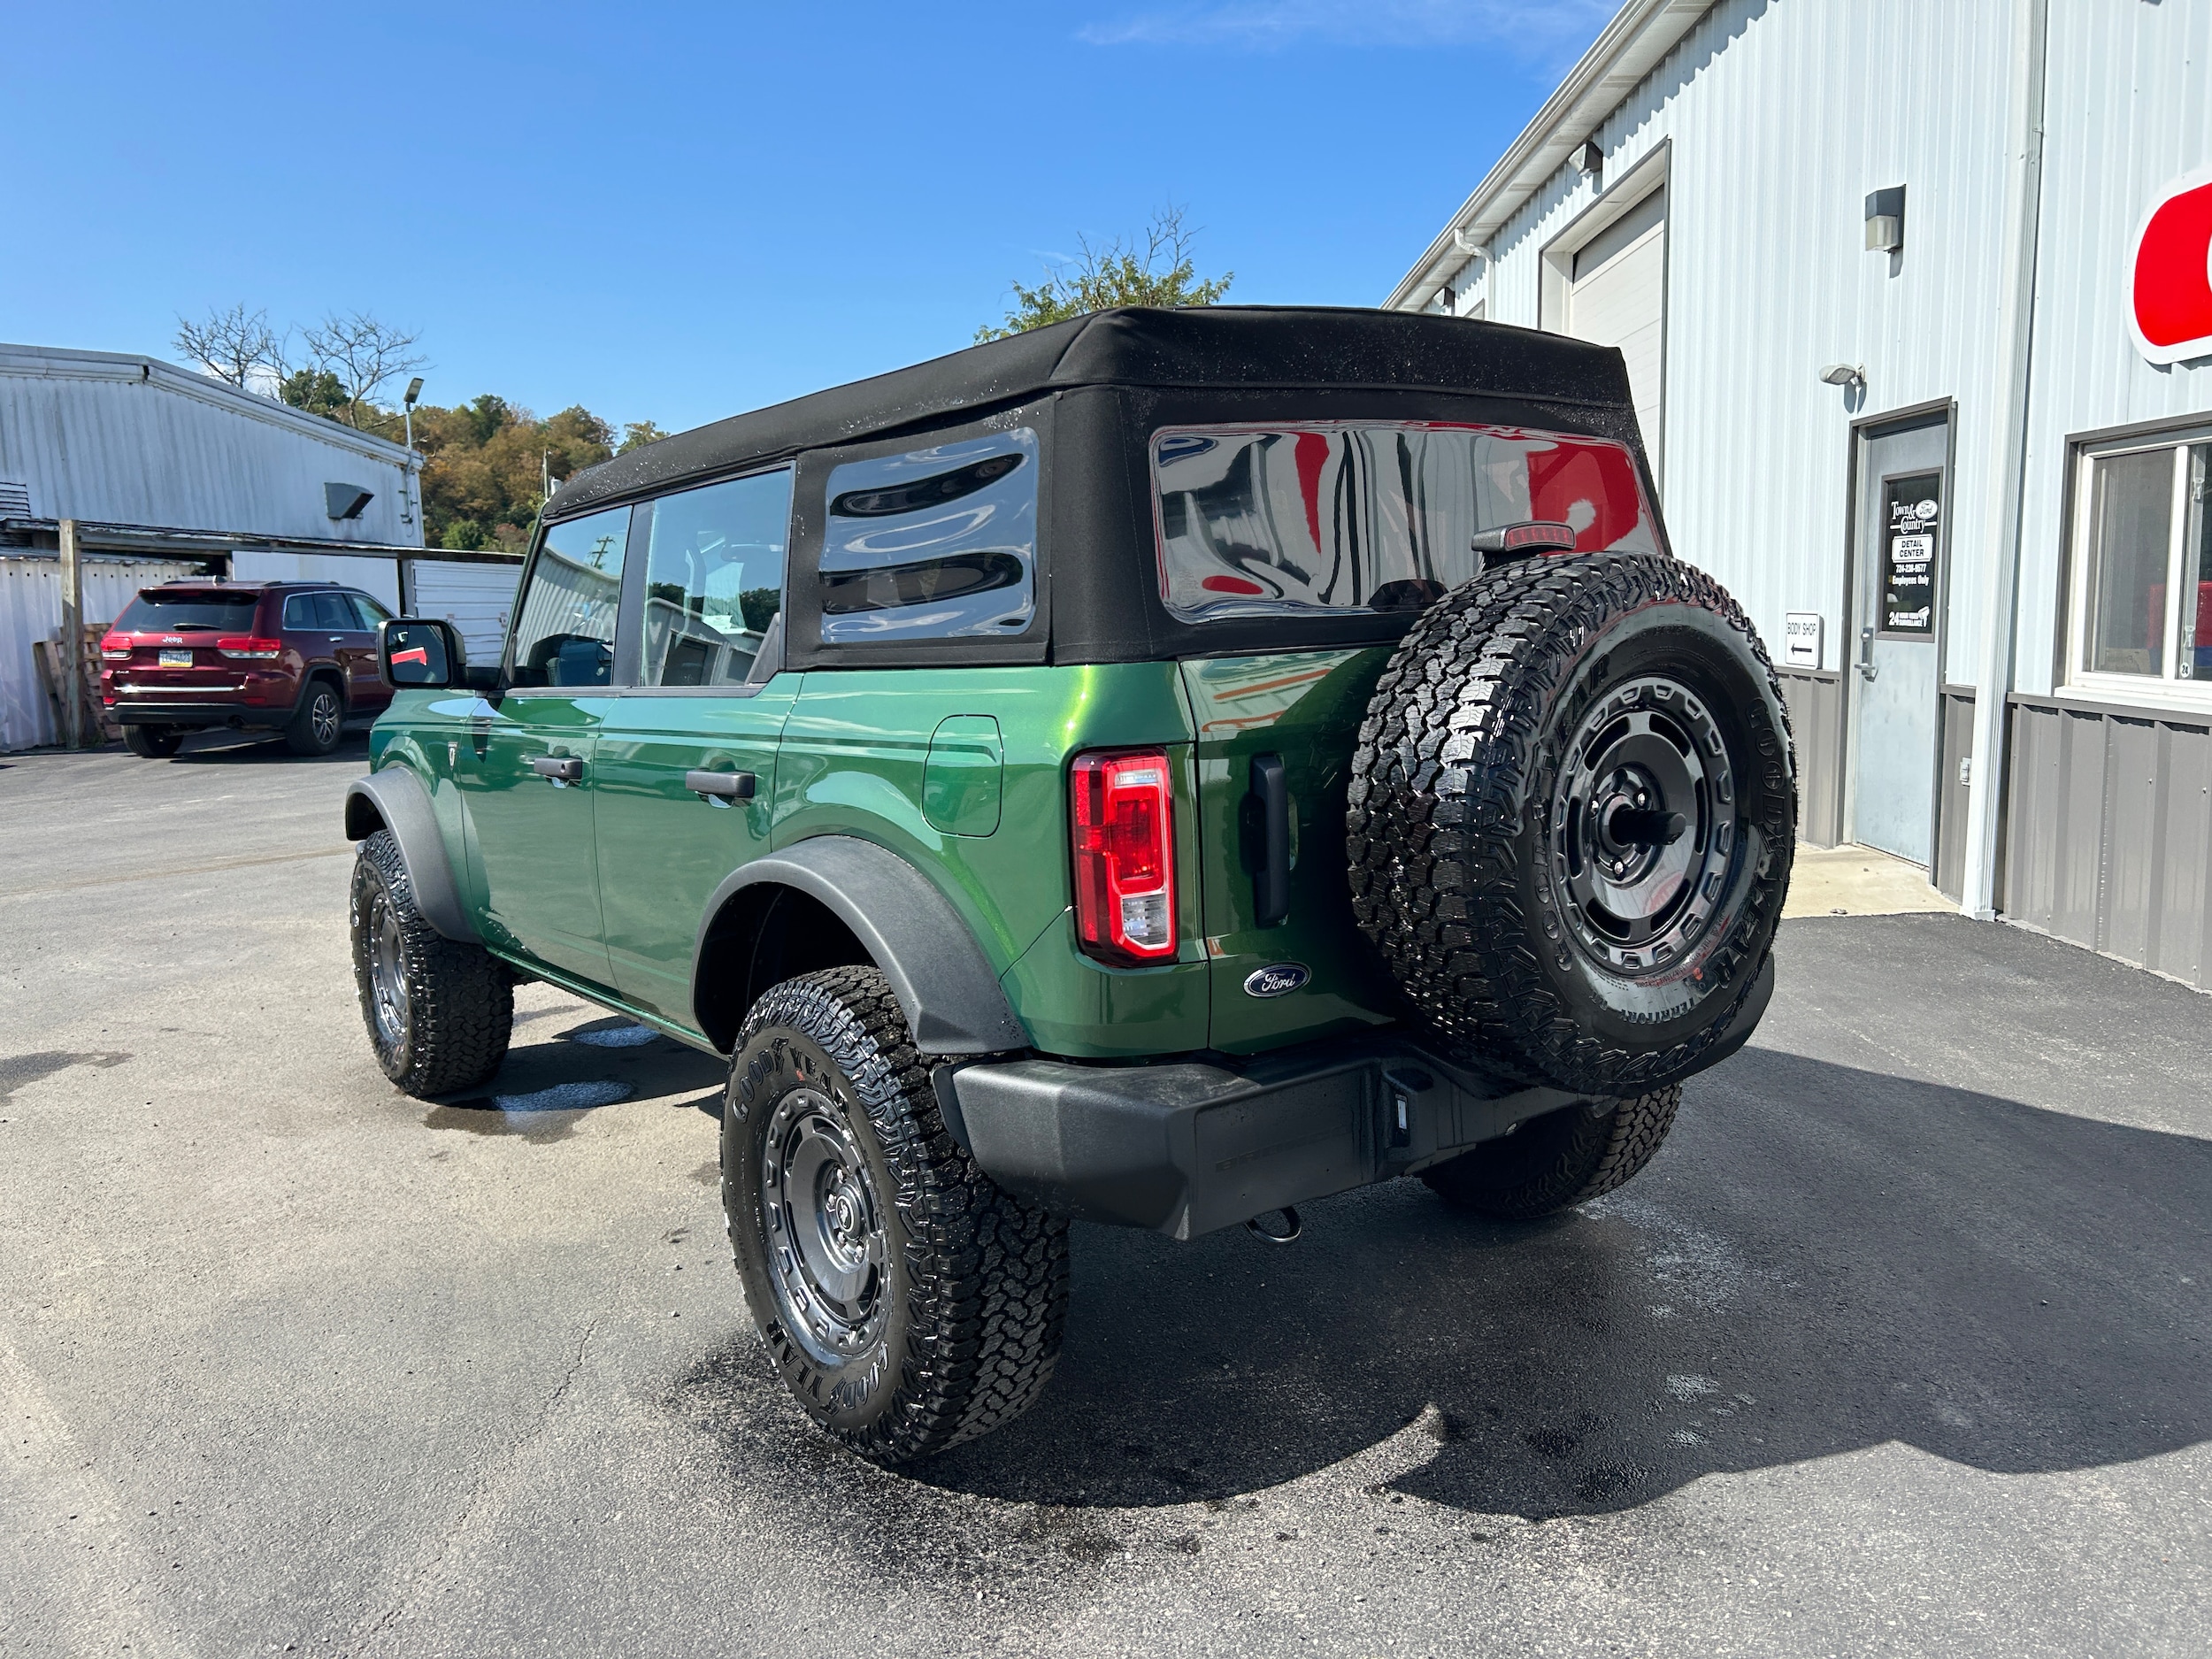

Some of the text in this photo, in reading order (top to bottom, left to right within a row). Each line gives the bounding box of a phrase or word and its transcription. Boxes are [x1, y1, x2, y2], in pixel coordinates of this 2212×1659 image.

[1891, 501, 1916, 520] Town &
[1901, 516, 1926, 534] Country
[1901, 539, 1923, 549] DETAIL
[1899, 549, 1924, 557] CENTER
[1892, 574, 1930, 587] Employees Only
[1888, 611, 1900, 626] 24
[1787, 622, 1816, 636] BODY SHOP
[162, 635, 183, 644] Jeep
[2181, 664, 2189, 675] 24
[1262, 973, 1295, 992] Ford
[1618, 997, 1697, 1025] TERRITORY
